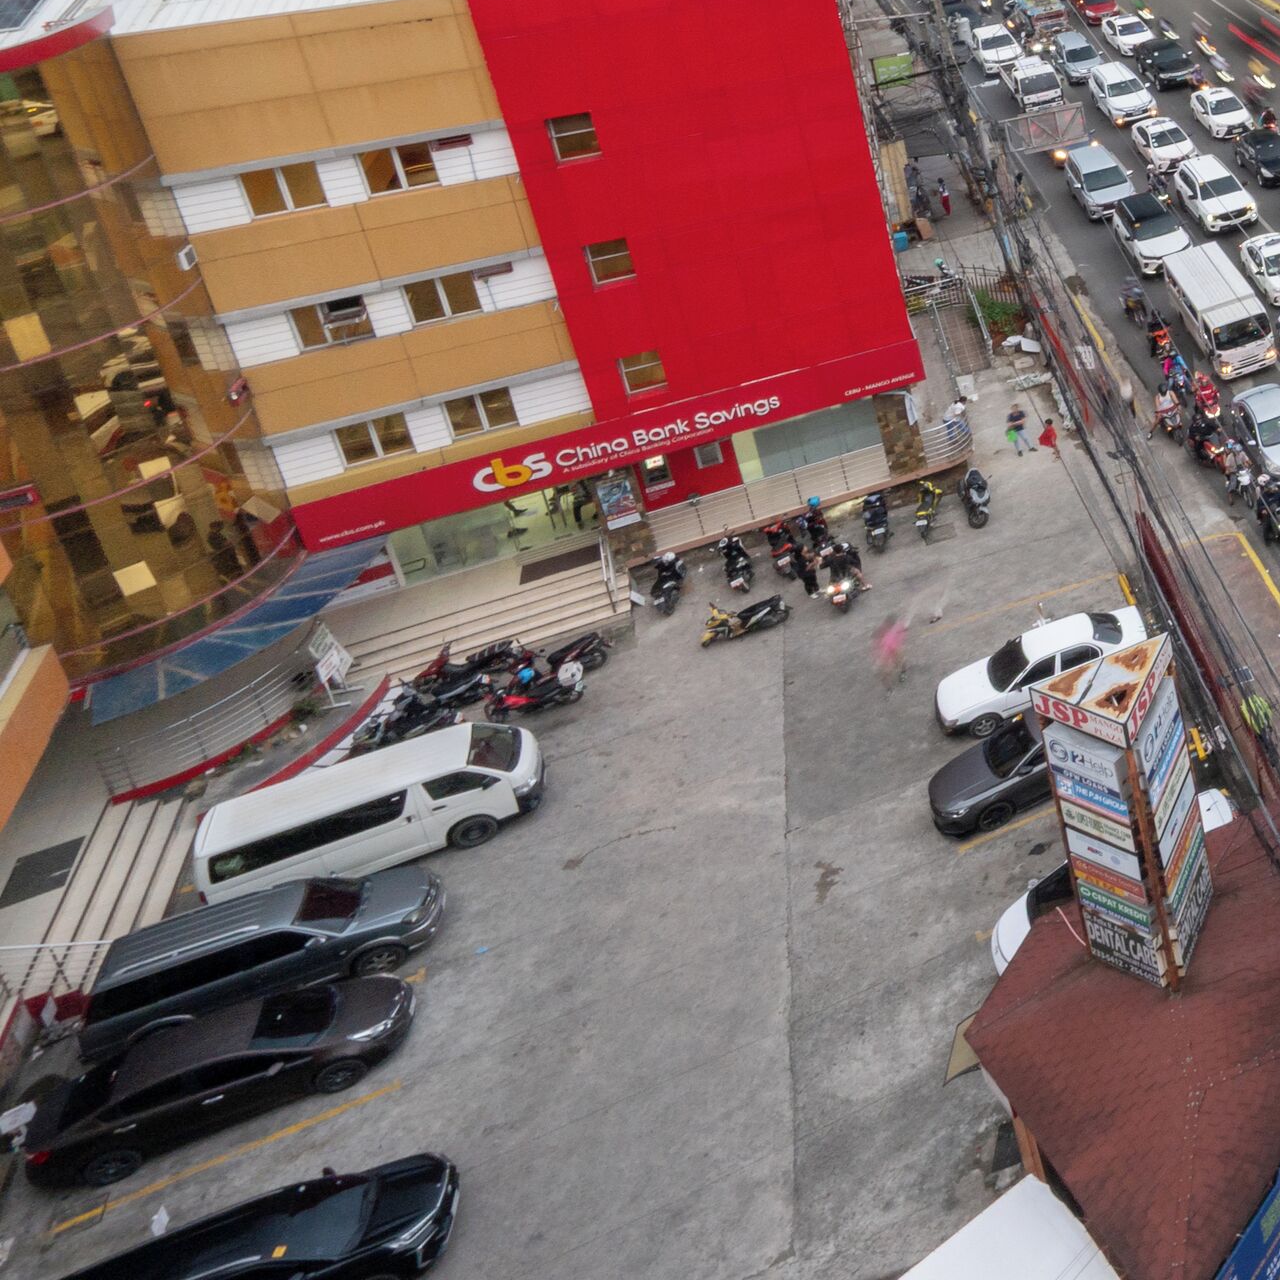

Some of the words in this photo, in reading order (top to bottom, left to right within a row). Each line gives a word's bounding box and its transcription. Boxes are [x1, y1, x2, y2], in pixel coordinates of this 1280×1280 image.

[844, 386, 862, 396] CEBU
[865, 380, 890, 391] MANGO
[890, 372, 915, 384] AVENUE
[555, 436, 630, 468] China
[632, 418, 690, 447] Bank
[694, 396, 781, 428] Savings
[571, 457, 609, 472] subsidiary
[618, 446, 640, 460] China
[642, 438, 671, 454] Banking
[672, 427, 714, 445] Corporation
[320, 520, 386, 542] www.cbs.com.ph
[1035, 694, 1089, 729] JSP
[1090, 715, 1123, 734] MANGO
[1130, 671, 1156, 742] JSP
[1094, 728, 1122, 744] PLAZA
[1118, 902, 1148, 922] KREDIT
[1087, 920, 1130, 956] DENTAL
[1129, 940, 1159, 971] CARE
